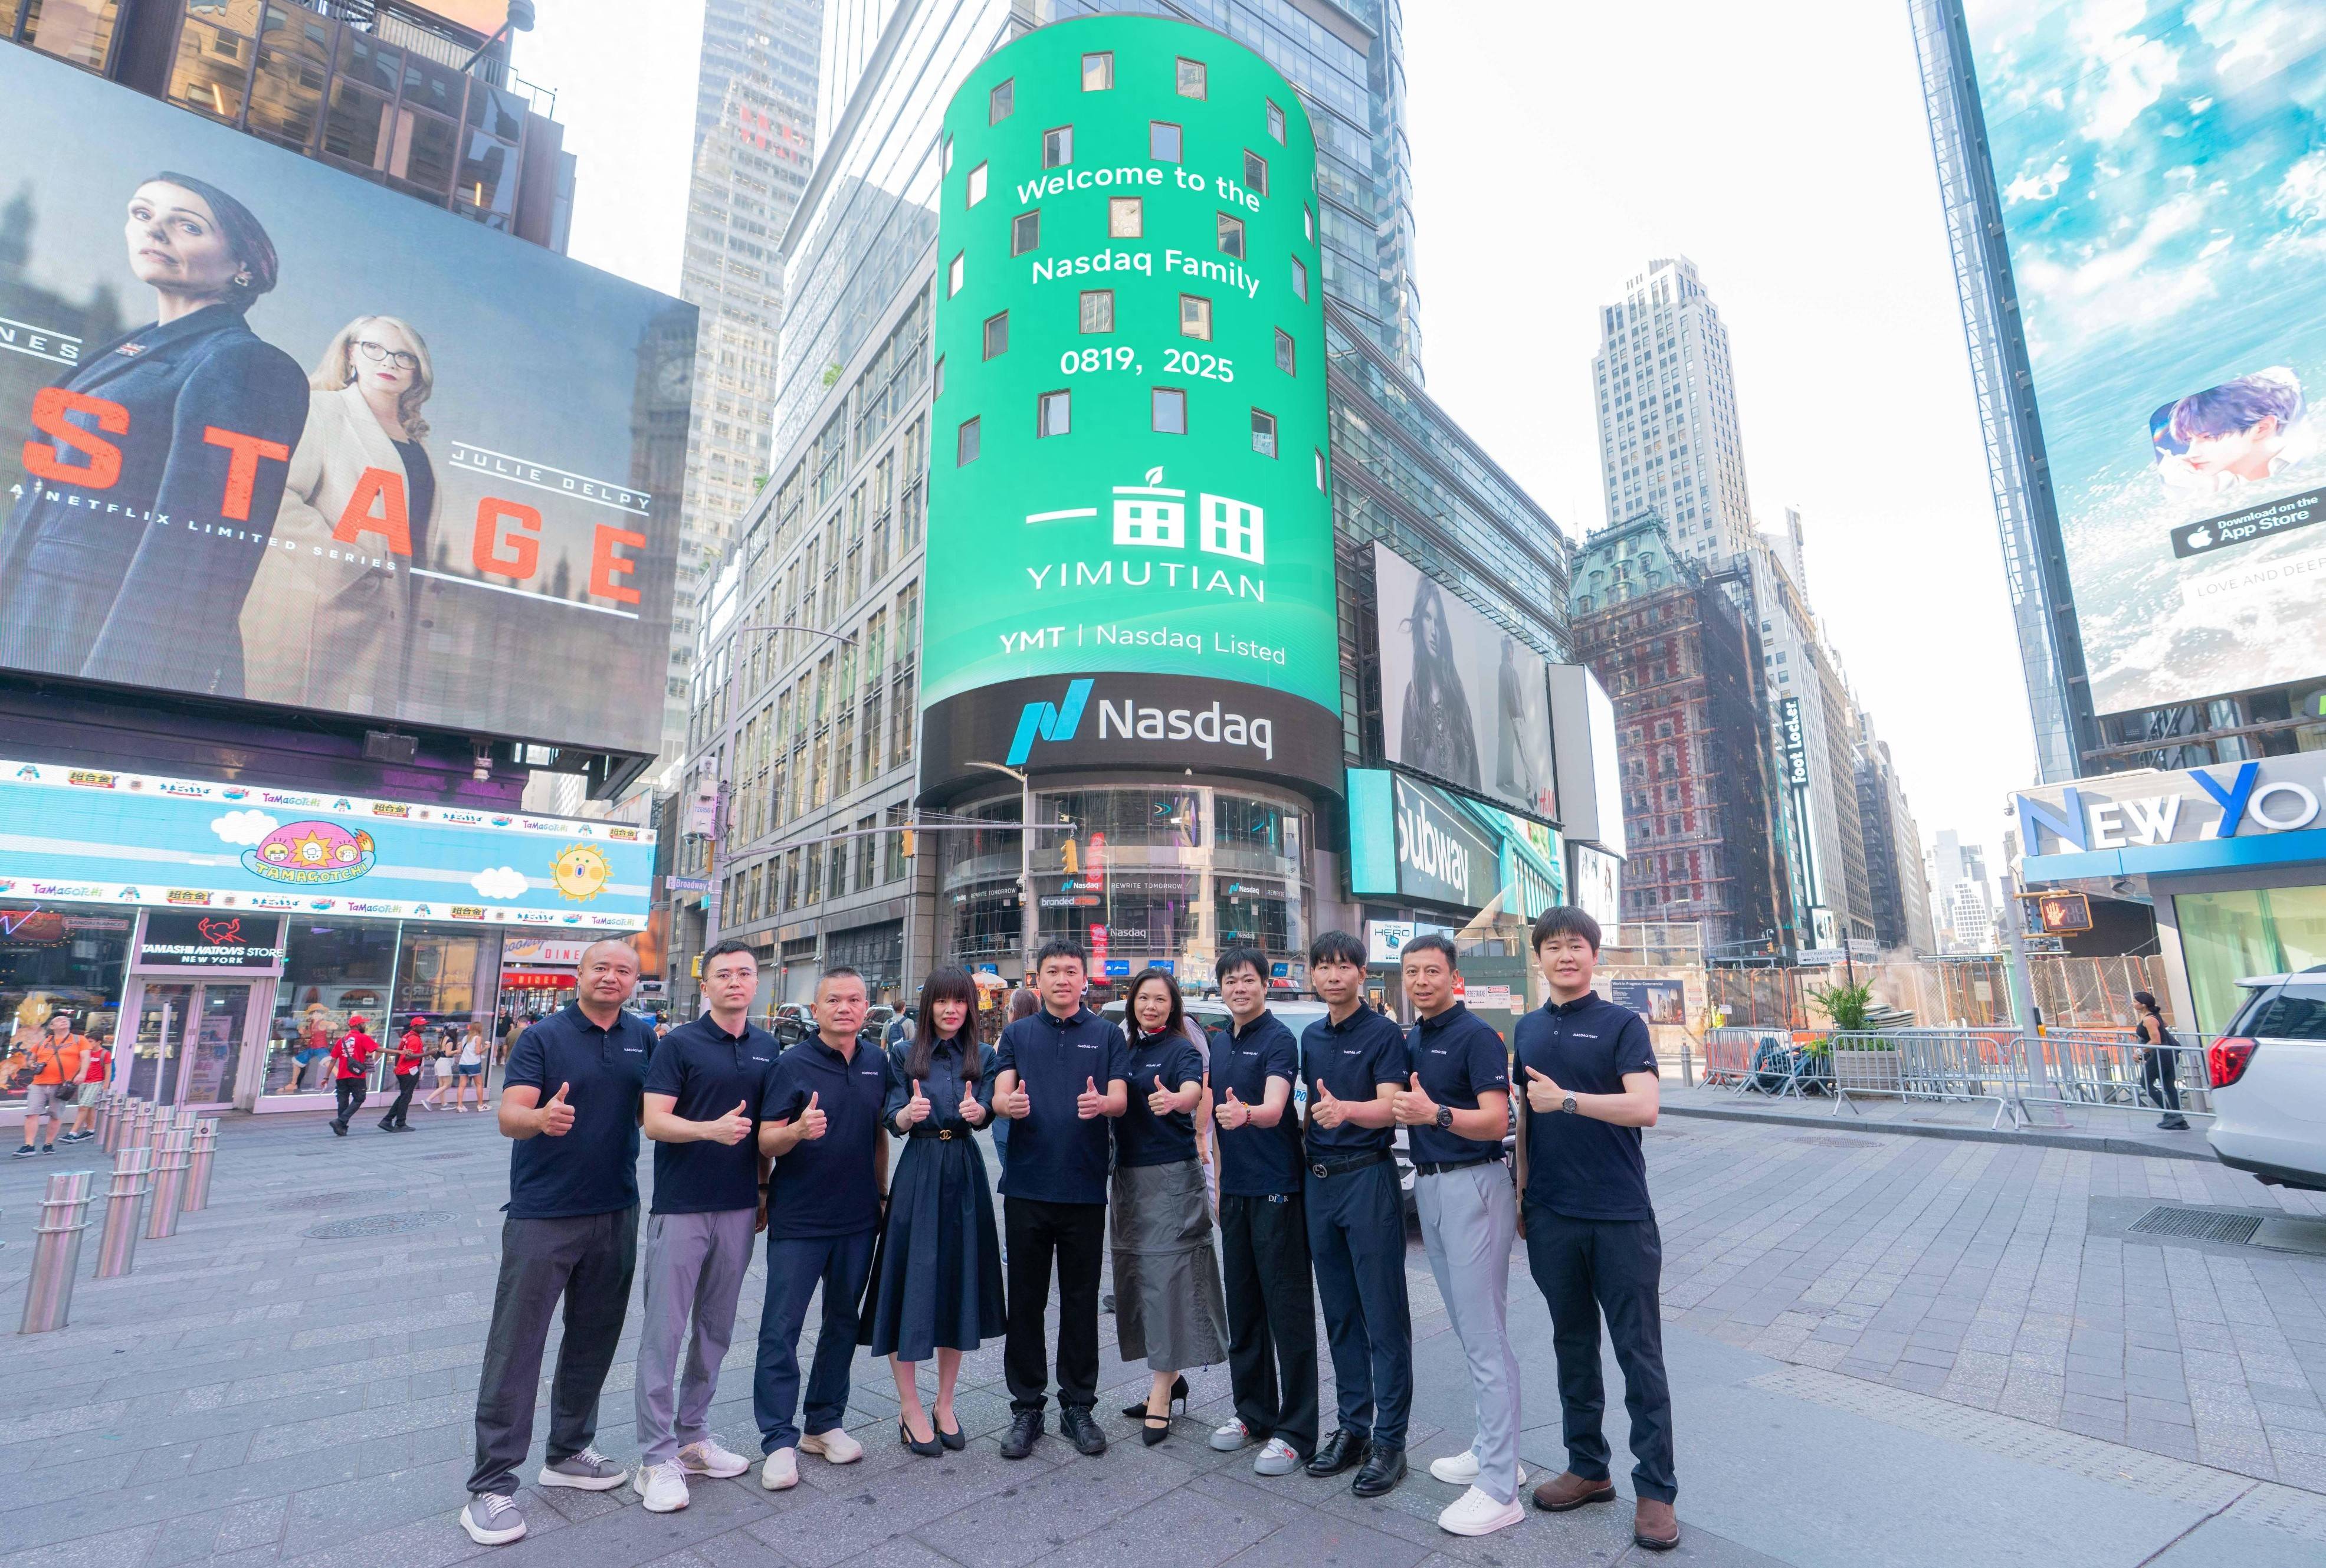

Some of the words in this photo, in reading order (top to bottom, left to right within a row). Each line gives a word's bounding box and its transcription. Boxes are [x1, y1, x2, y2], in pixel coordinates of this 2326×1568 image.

[1016, 166, 1164, 205] Welcome
[1175, 166, 1206, 192] to
[1215, 175, 1261, 214] the
[1032, 248, 1153, 286] Nasdaq
[1164, 248, 1261, 300] Family
[1061, 345, 1143, 376] 0819,
[1162, 347, 1235, 383] 2025
[451, 448, 542, 483] JULIE
[562, 477, 650, 510] DELPY
[9, 483, 24, 494] A
[46, 490, 170, 524] NETFLIX
[188, 520, 296, 550] LIMITED
[313, 546, 396, 570] SERIES
[2217, 507, 2277, 530] Download
[2279, 501, 2295, 513] on
[2297, 496, 2319, 508] the
[2220, 524, 2257, 542] App
[2259, 509, 2310, 530] Store
[1026, 560, 1265, 603] YIMUTIAN
[2197, 579, 2239, 597] LOVE
[2243, 569, 2278, 586] AND
[999, 625, 1066, 654] YMT
[1096, 624, 1203, 655] Nasdaq
[1213, 631, 1287, 667] Listed
[1098, 699, 1273, 761] Nasdaq
[1789, 751, 1807, 783] Foot
[2016, 786, 2183, 857] NEW
[2187, 762, 2326, 838] YO
[1396, 779, 1469, 907] Subway
[255, 861, 369, 883] TAMAGOTCHI
[676, 878, 709, 891] Broadway
[1073, 881, 1100, 890] Nasdaq
[970, 890, 988, 899] REWRITE
[989, 887, 1016, 896] TOMORROW
[1239, 885, 1259, 895] Nasdaq
[1110, 928, 1147, 939] Nasdaq
[1237, 931, 1255, 940] Nasdaq
[1374, 929, 1410, 937] HERO
[141, 944, 195, 954] TAMASHII
[194, 945, 245, 956] NATIONS
[247, 947, 284, 957] STORE
[211, 956, 244, 965] YORK
[544, 949, 580, 960] DINE
[518, 975, 558, 985] DINER
[1294, 1090, 1307, 1102] PO
